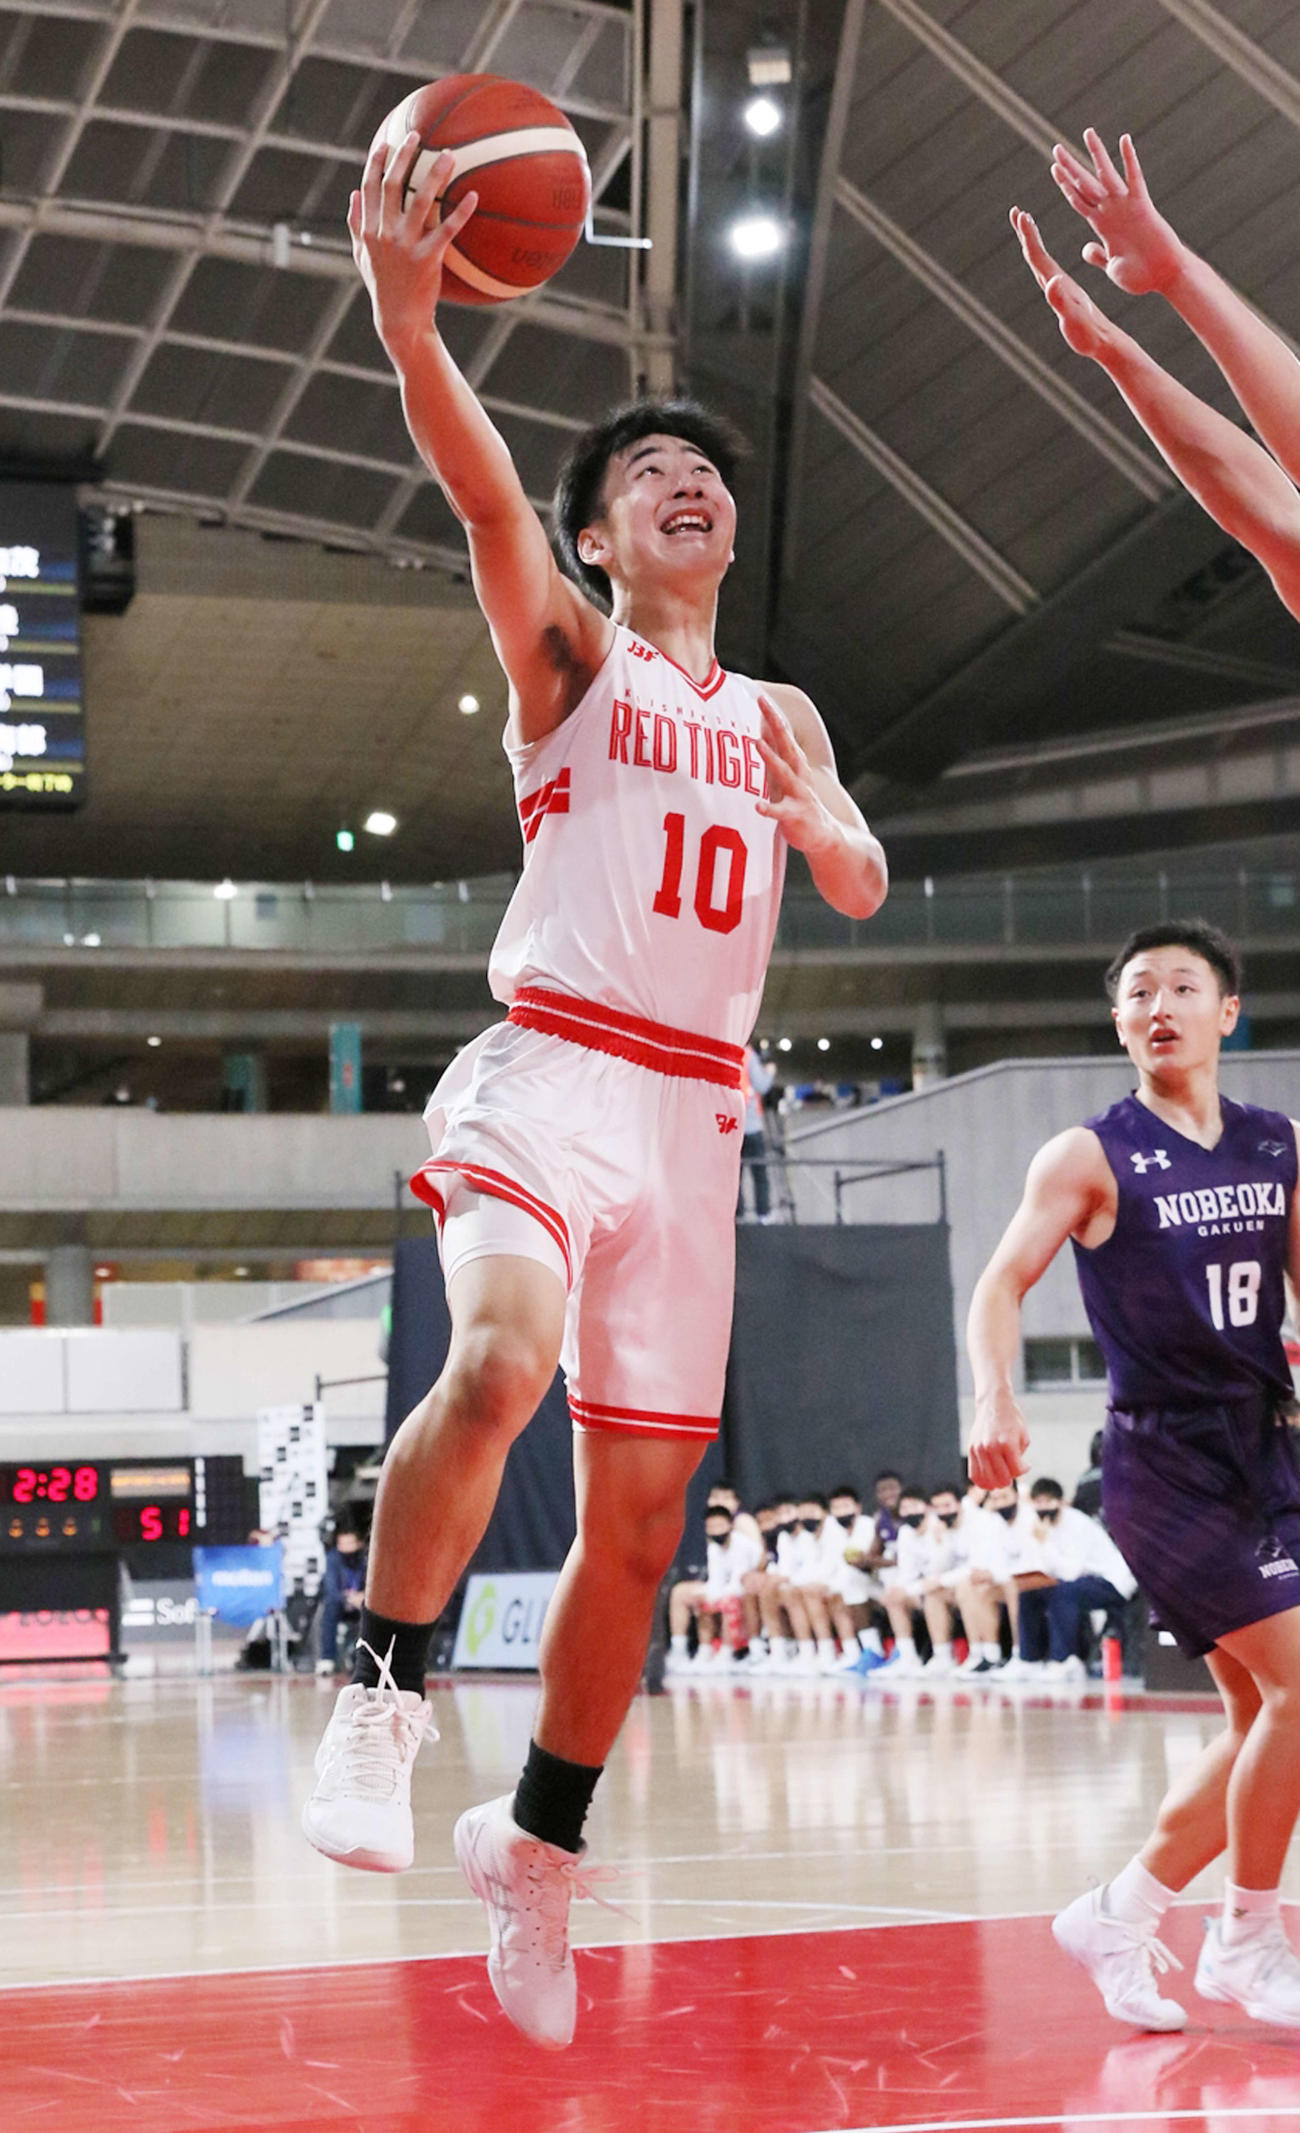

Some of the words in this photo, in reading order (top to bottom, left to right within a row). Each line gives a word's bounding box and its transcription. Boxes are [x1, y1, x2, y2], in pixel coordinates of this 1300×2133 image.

[608, 699, 677, 774] RED
[683, 720, 769, 800] TIGE
[653, 812, 748, 935] 10
[1153, 1182, 1286, 1229] NOBEOKA
[1198, 1219, 1265, 1237] GAKUEN
[1206, 1260, 1261, 1331] 18
[13, 1467, 98, 1503] 2:28
[139, 1504, 191, 1541] 51
[156, 1597, 199, 1626] Sof
